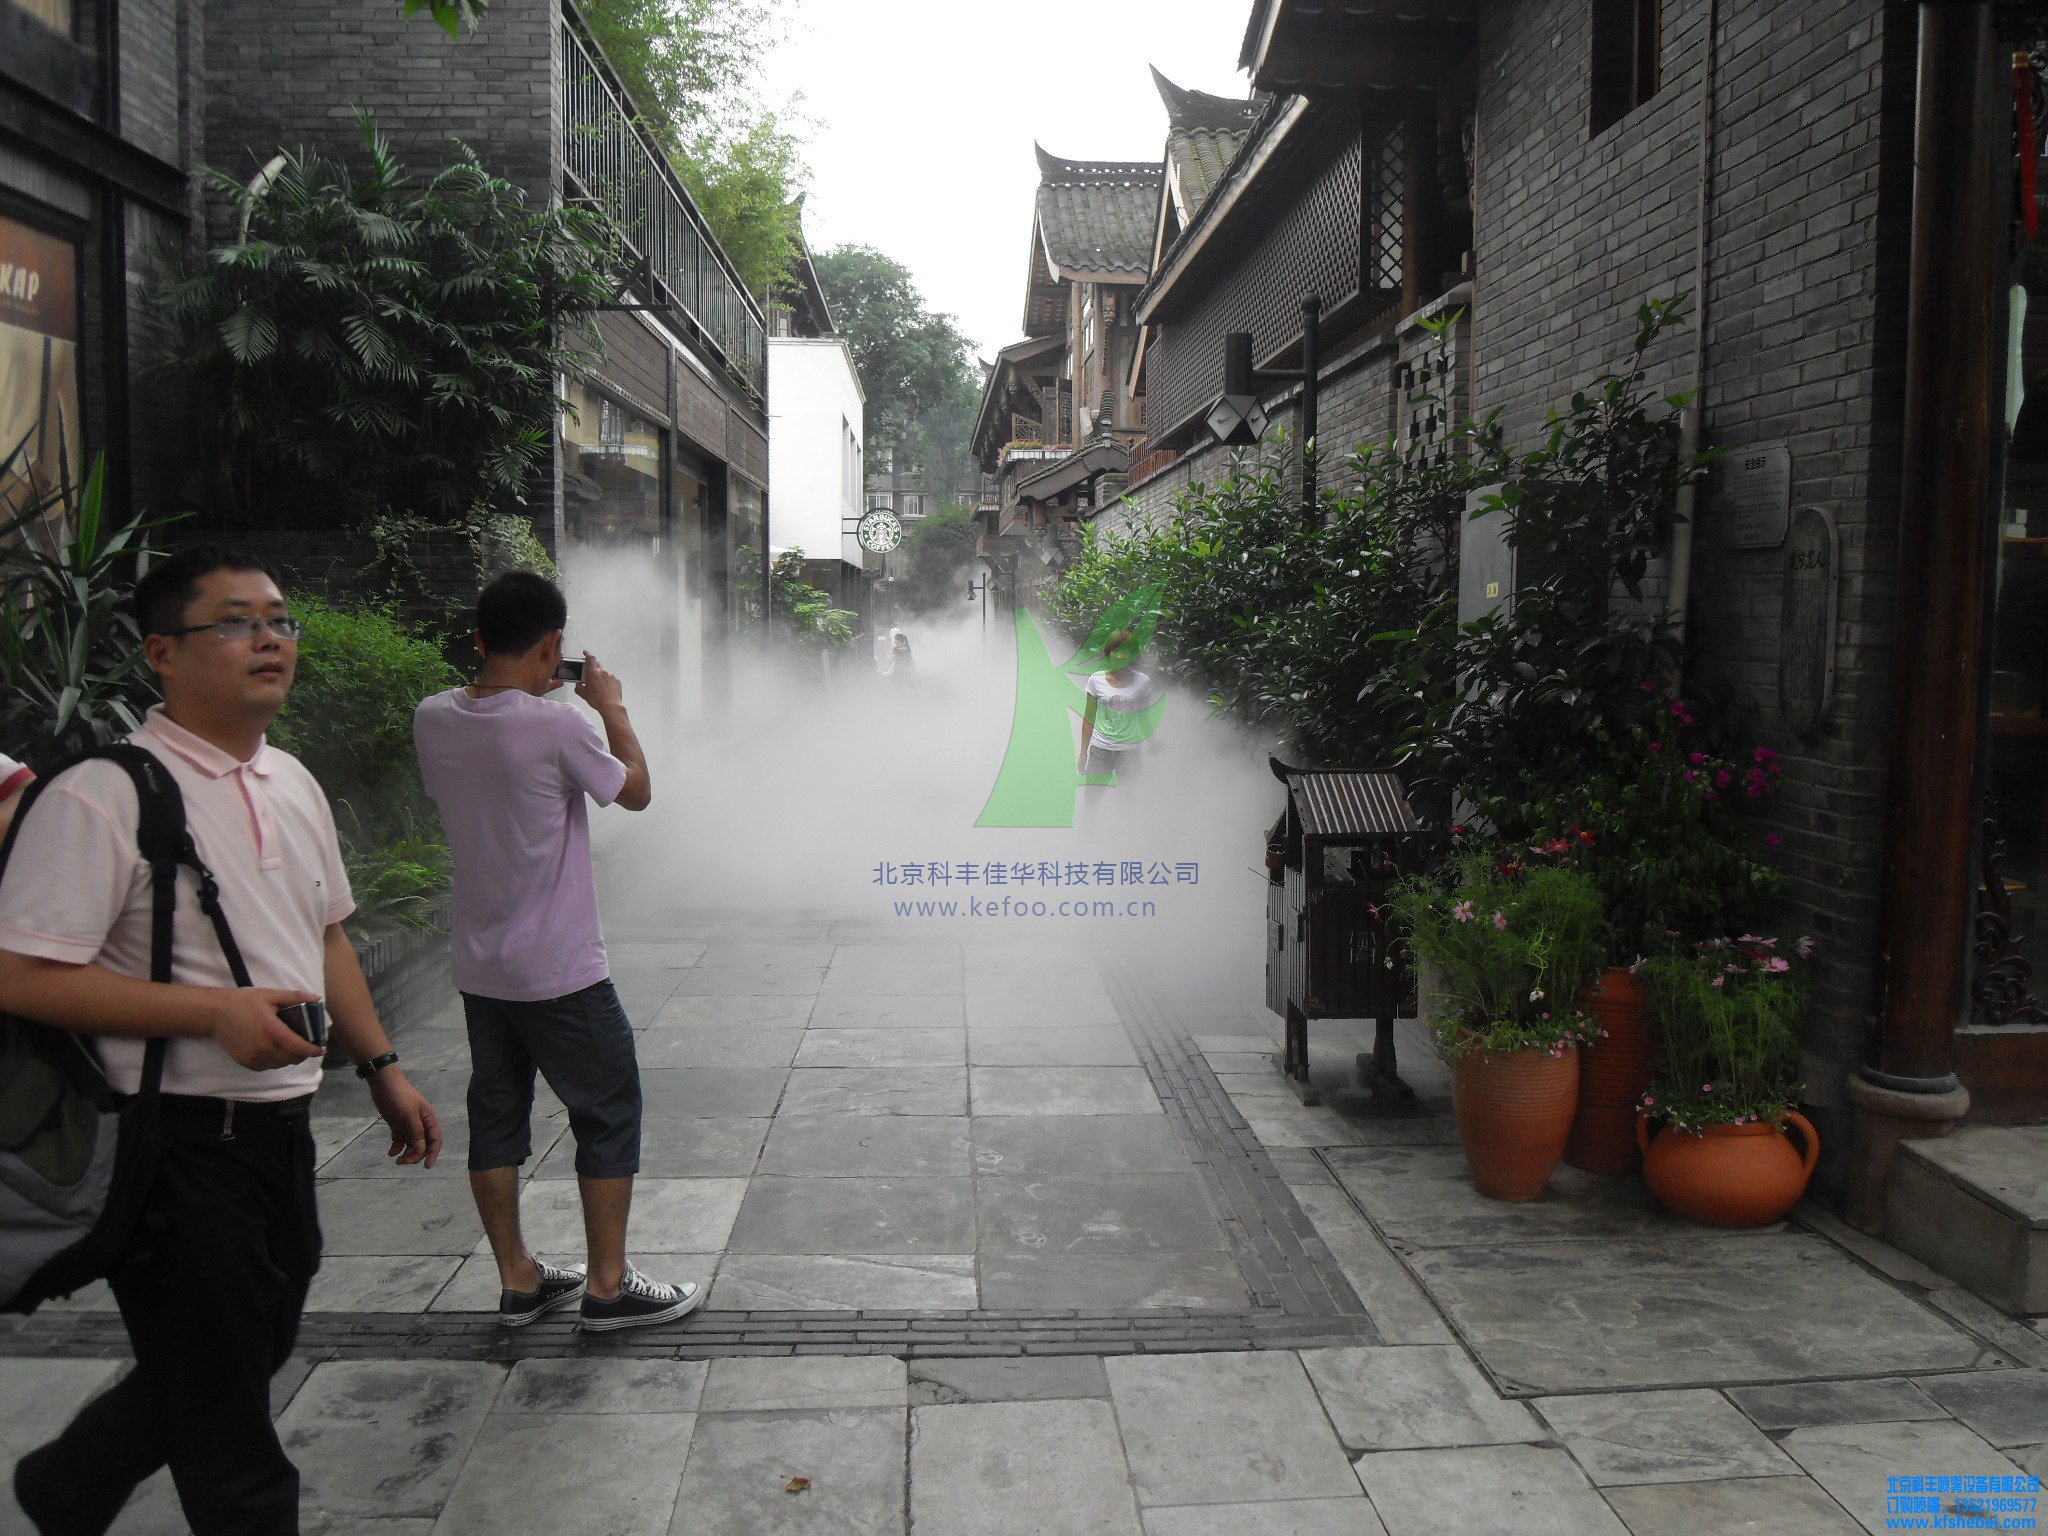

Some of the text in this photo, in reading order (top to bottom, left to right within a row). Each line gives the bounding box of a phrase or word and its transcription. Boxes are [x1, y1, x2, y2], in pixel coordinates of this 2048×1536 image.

[1744, 456, 1767, 471] 安全提示
[863, 514, 900, 533] STARBUCKS
[866, 540, 896, 552] COFFEE
